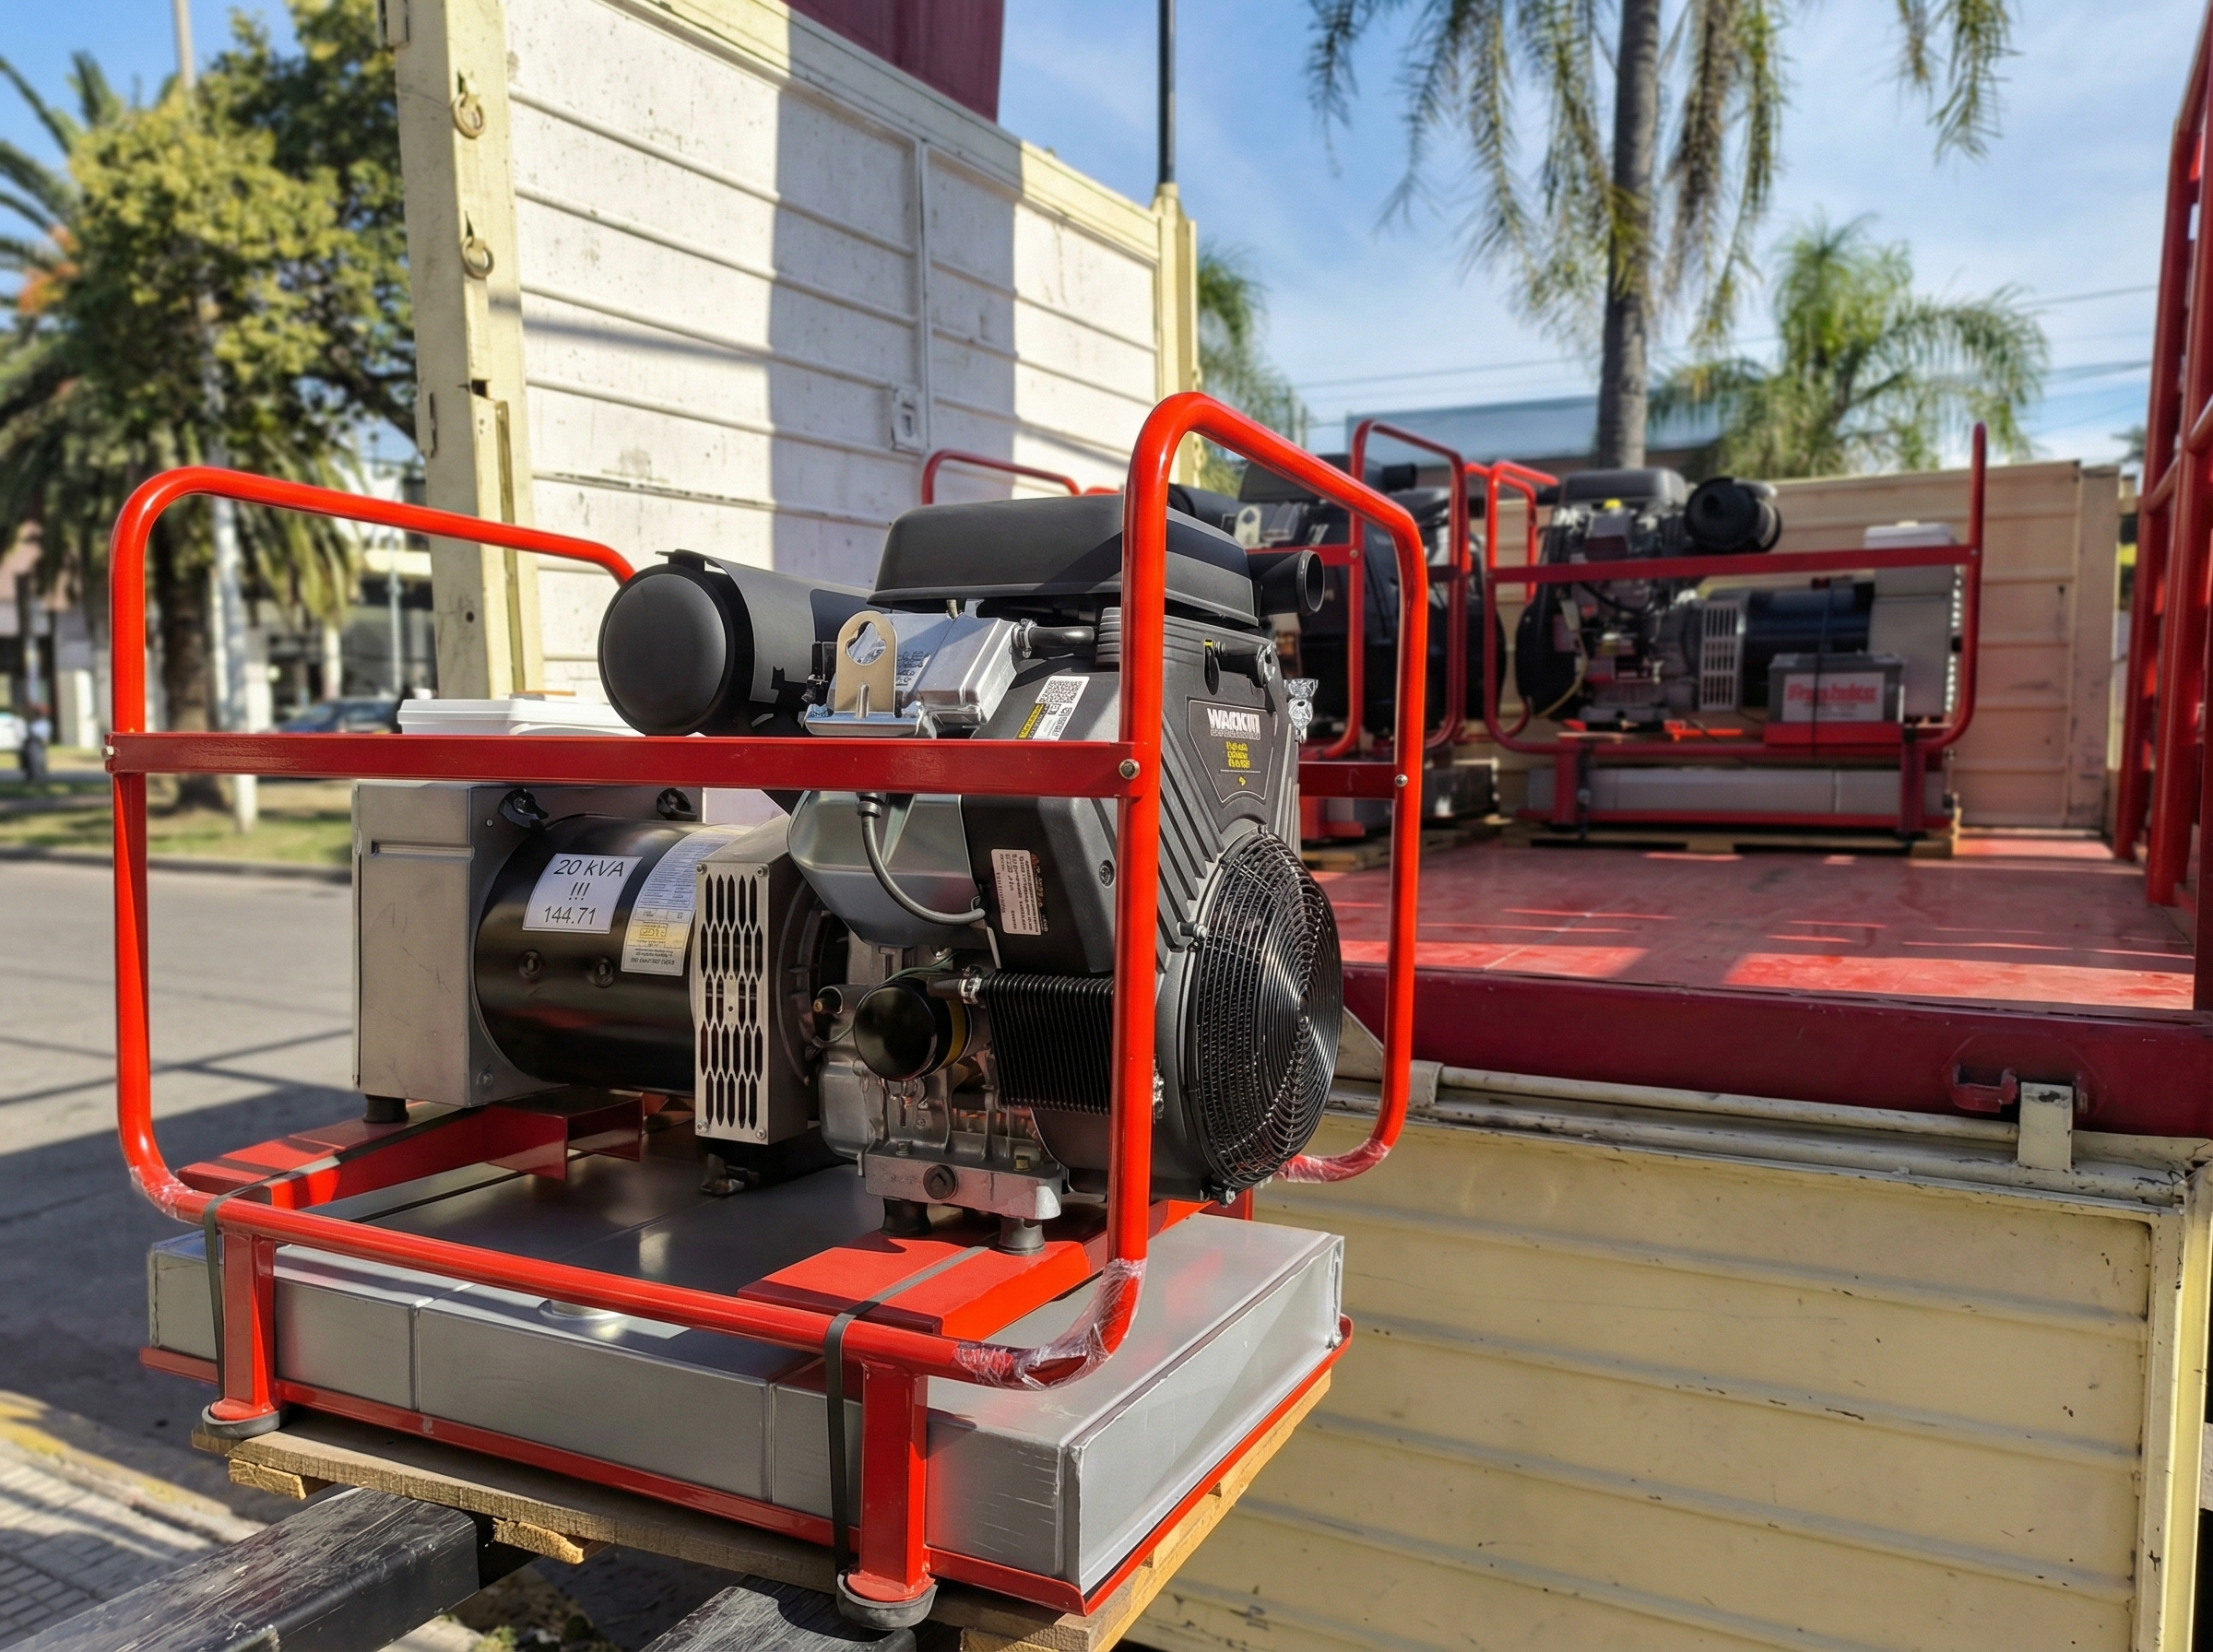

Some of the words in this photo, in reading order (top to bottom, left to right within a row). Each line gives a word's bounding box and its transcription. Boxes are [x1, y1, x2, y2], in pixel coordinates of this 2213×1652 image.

[553, 859, 583, 875] 20
[583, 859, 624, 877] kVA
[568, 881, 590, 901] !!!
[544, 905, 597, 925] 144.71
